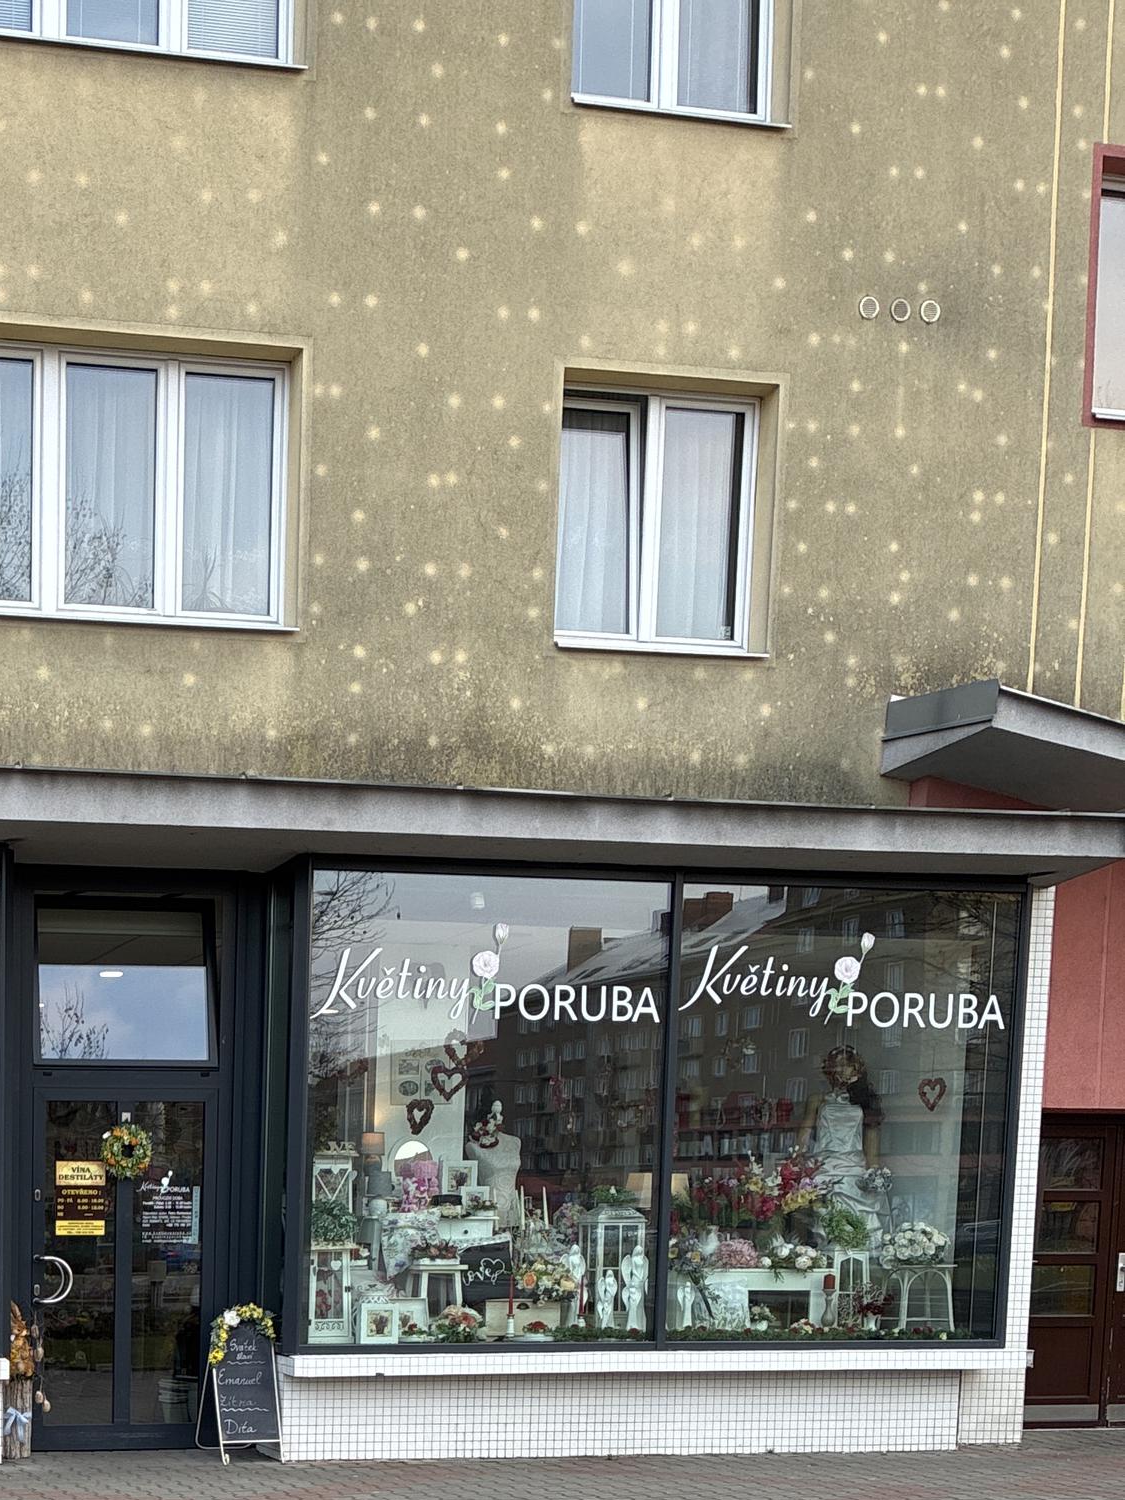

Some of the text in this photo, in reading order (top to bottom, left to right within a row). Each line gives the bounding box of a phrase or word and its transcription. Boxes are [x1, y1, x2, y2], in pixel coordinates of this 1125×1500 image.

[310, 947, 660, 1024] Květiny PORUBA
[678, 944, 1006, 1030] Květiny PORUBA
[58, 1172, 104, 1181] DESTILÁTY
[71, 1165, 91, 1173] VÍNA
[218, 1368, 262, 1385] Emanuel
